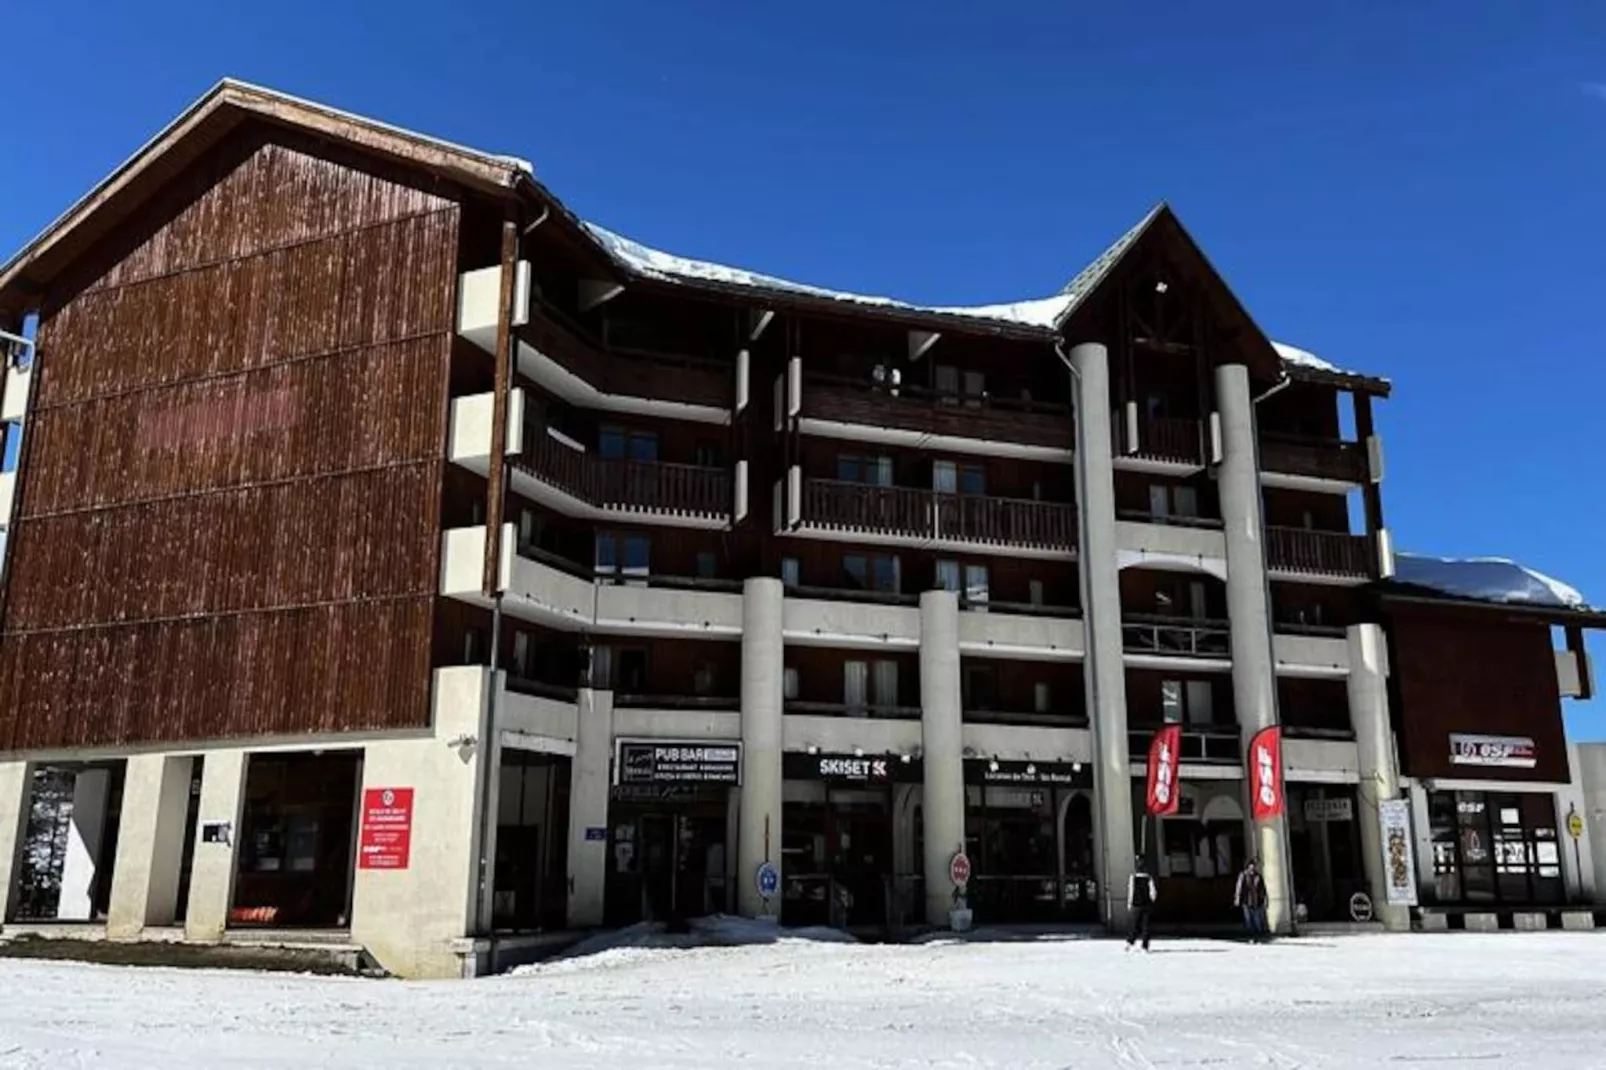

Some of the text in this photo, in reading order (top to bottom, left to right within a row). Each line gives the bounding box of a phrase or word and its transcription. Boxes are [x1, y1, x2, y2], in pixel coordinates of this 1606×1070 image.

[655, 748, 680, 761] PUB
[680, 748, 704, 761] BAR
[820, 759, 870, 775] SKISET
[1257, 745, 1276, 806] esf
[1457, 802, 1484, 813] esf
